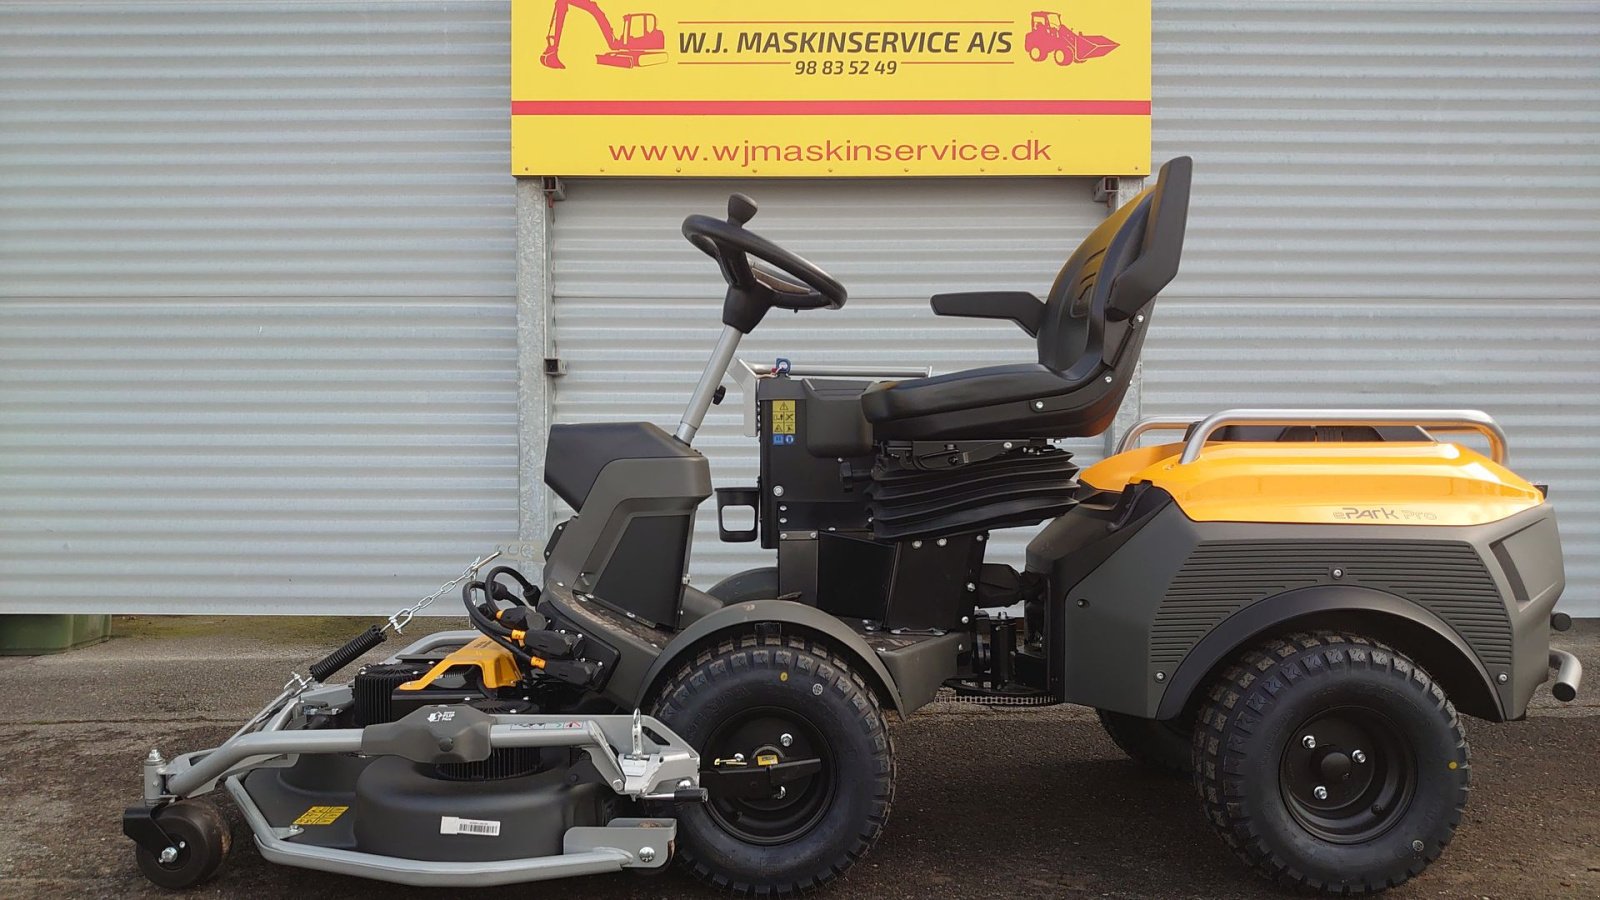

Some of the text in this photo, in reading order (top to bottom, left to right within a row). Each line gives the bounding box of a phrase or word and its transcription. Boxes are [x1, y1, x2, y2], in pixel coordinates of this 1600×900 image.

[679, 32, 1012, 54] W.J. MASKINSERVICE A/S
[795, 61, 897, 75] 98 83 52 49
[609, 140, 1051, 166] www.wjmaskinservice.dk
